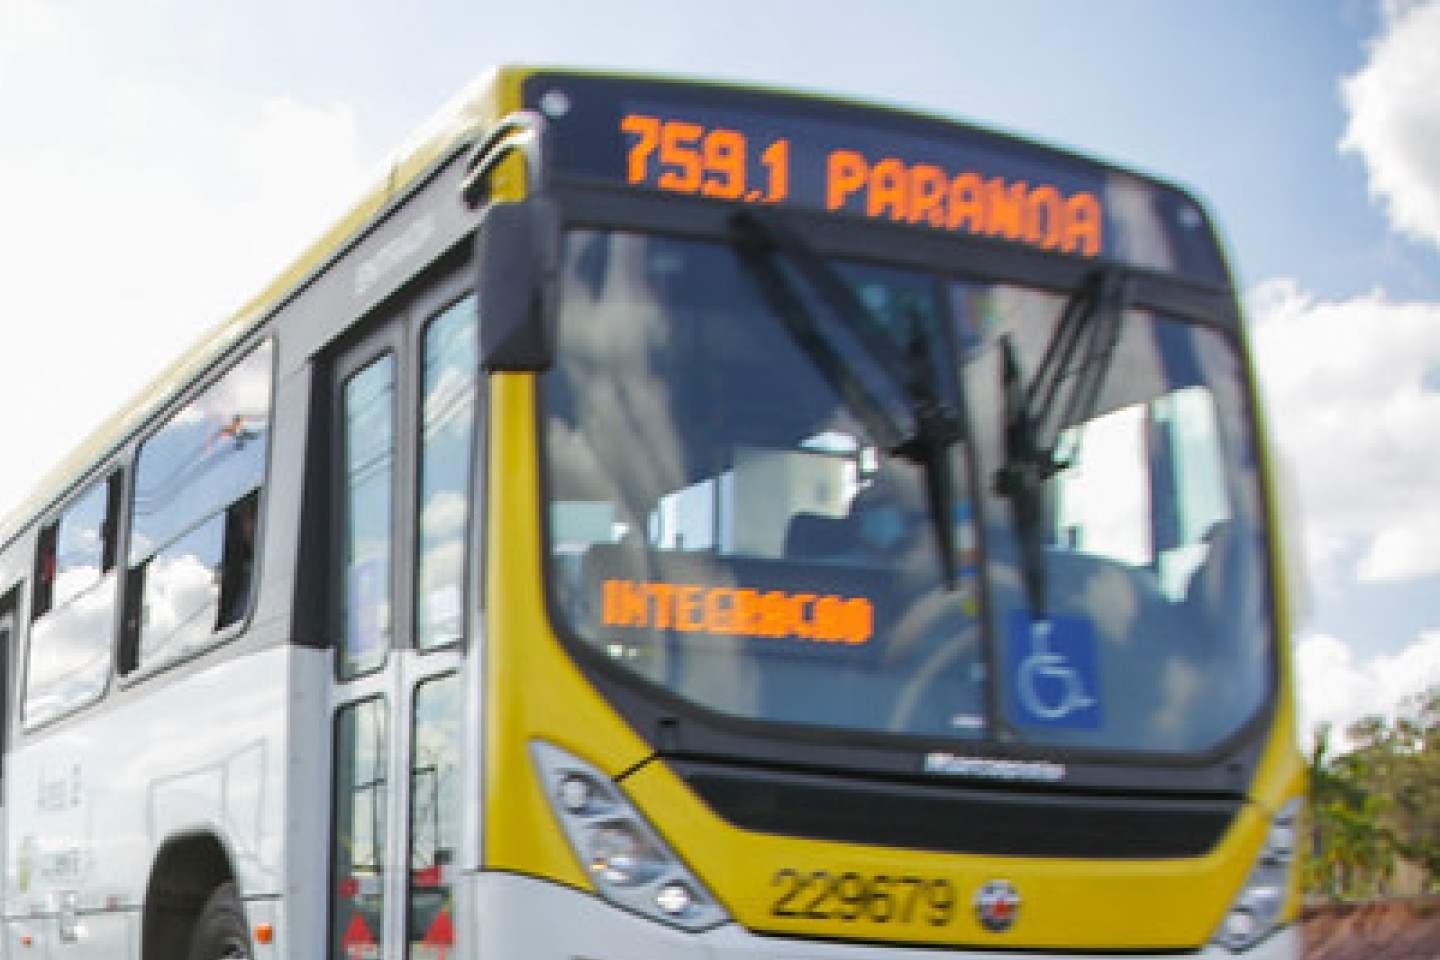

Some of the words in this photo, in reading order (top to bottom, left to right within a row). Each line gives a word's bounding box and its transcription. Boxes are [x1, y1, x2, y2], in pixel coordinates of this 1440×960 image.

[620, 114, 790, 203] 759.1
[827, 149, 1102, 258] PARANOA
[771, 866, 957, 928] 229679
